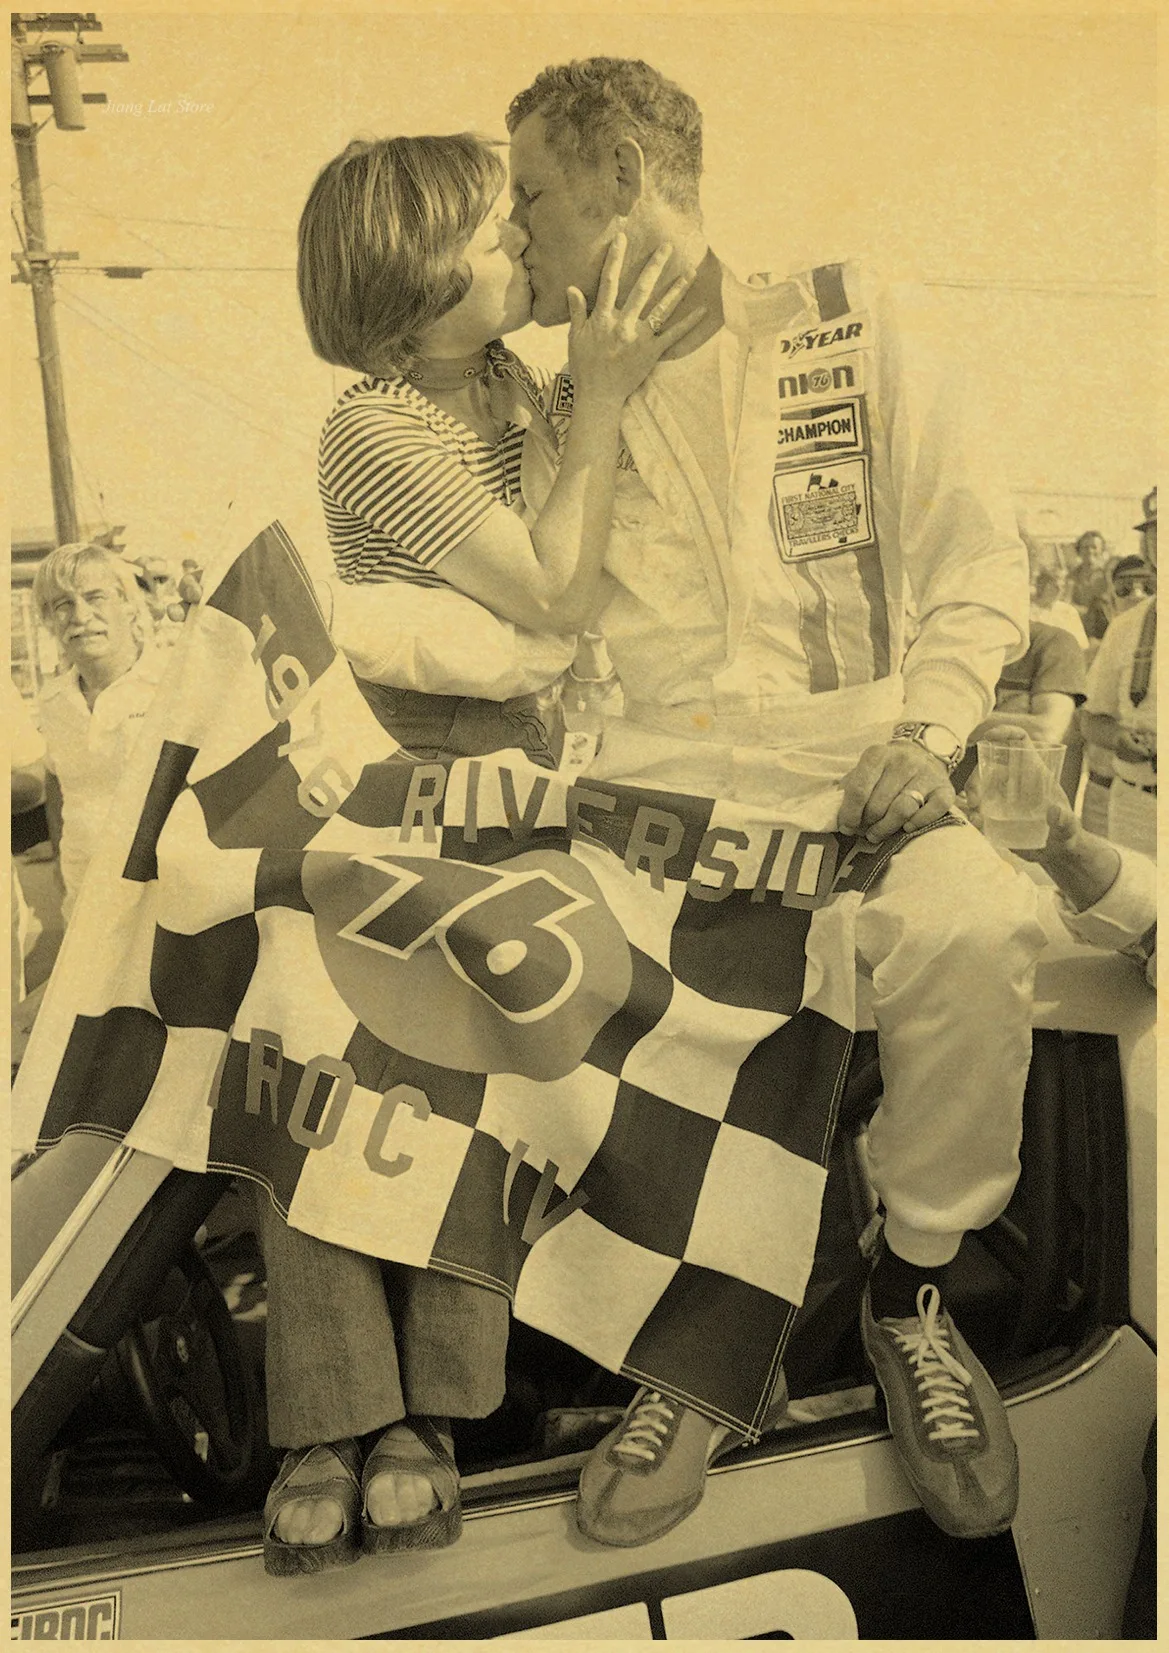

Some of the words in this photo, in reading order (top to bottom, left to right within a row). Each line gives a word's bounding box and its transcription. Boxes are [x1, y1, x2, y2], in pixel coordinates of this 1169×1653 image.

[812, 373, 829, 388] 76
[805, 487, 840, 500] NATIONAL
[841, 483, 856, 493] CITY
[250, 613, 355, 819] 1976
[398, 757, 885, 912] RIVERSIDE
[336, 852, 595, 1024] 76
